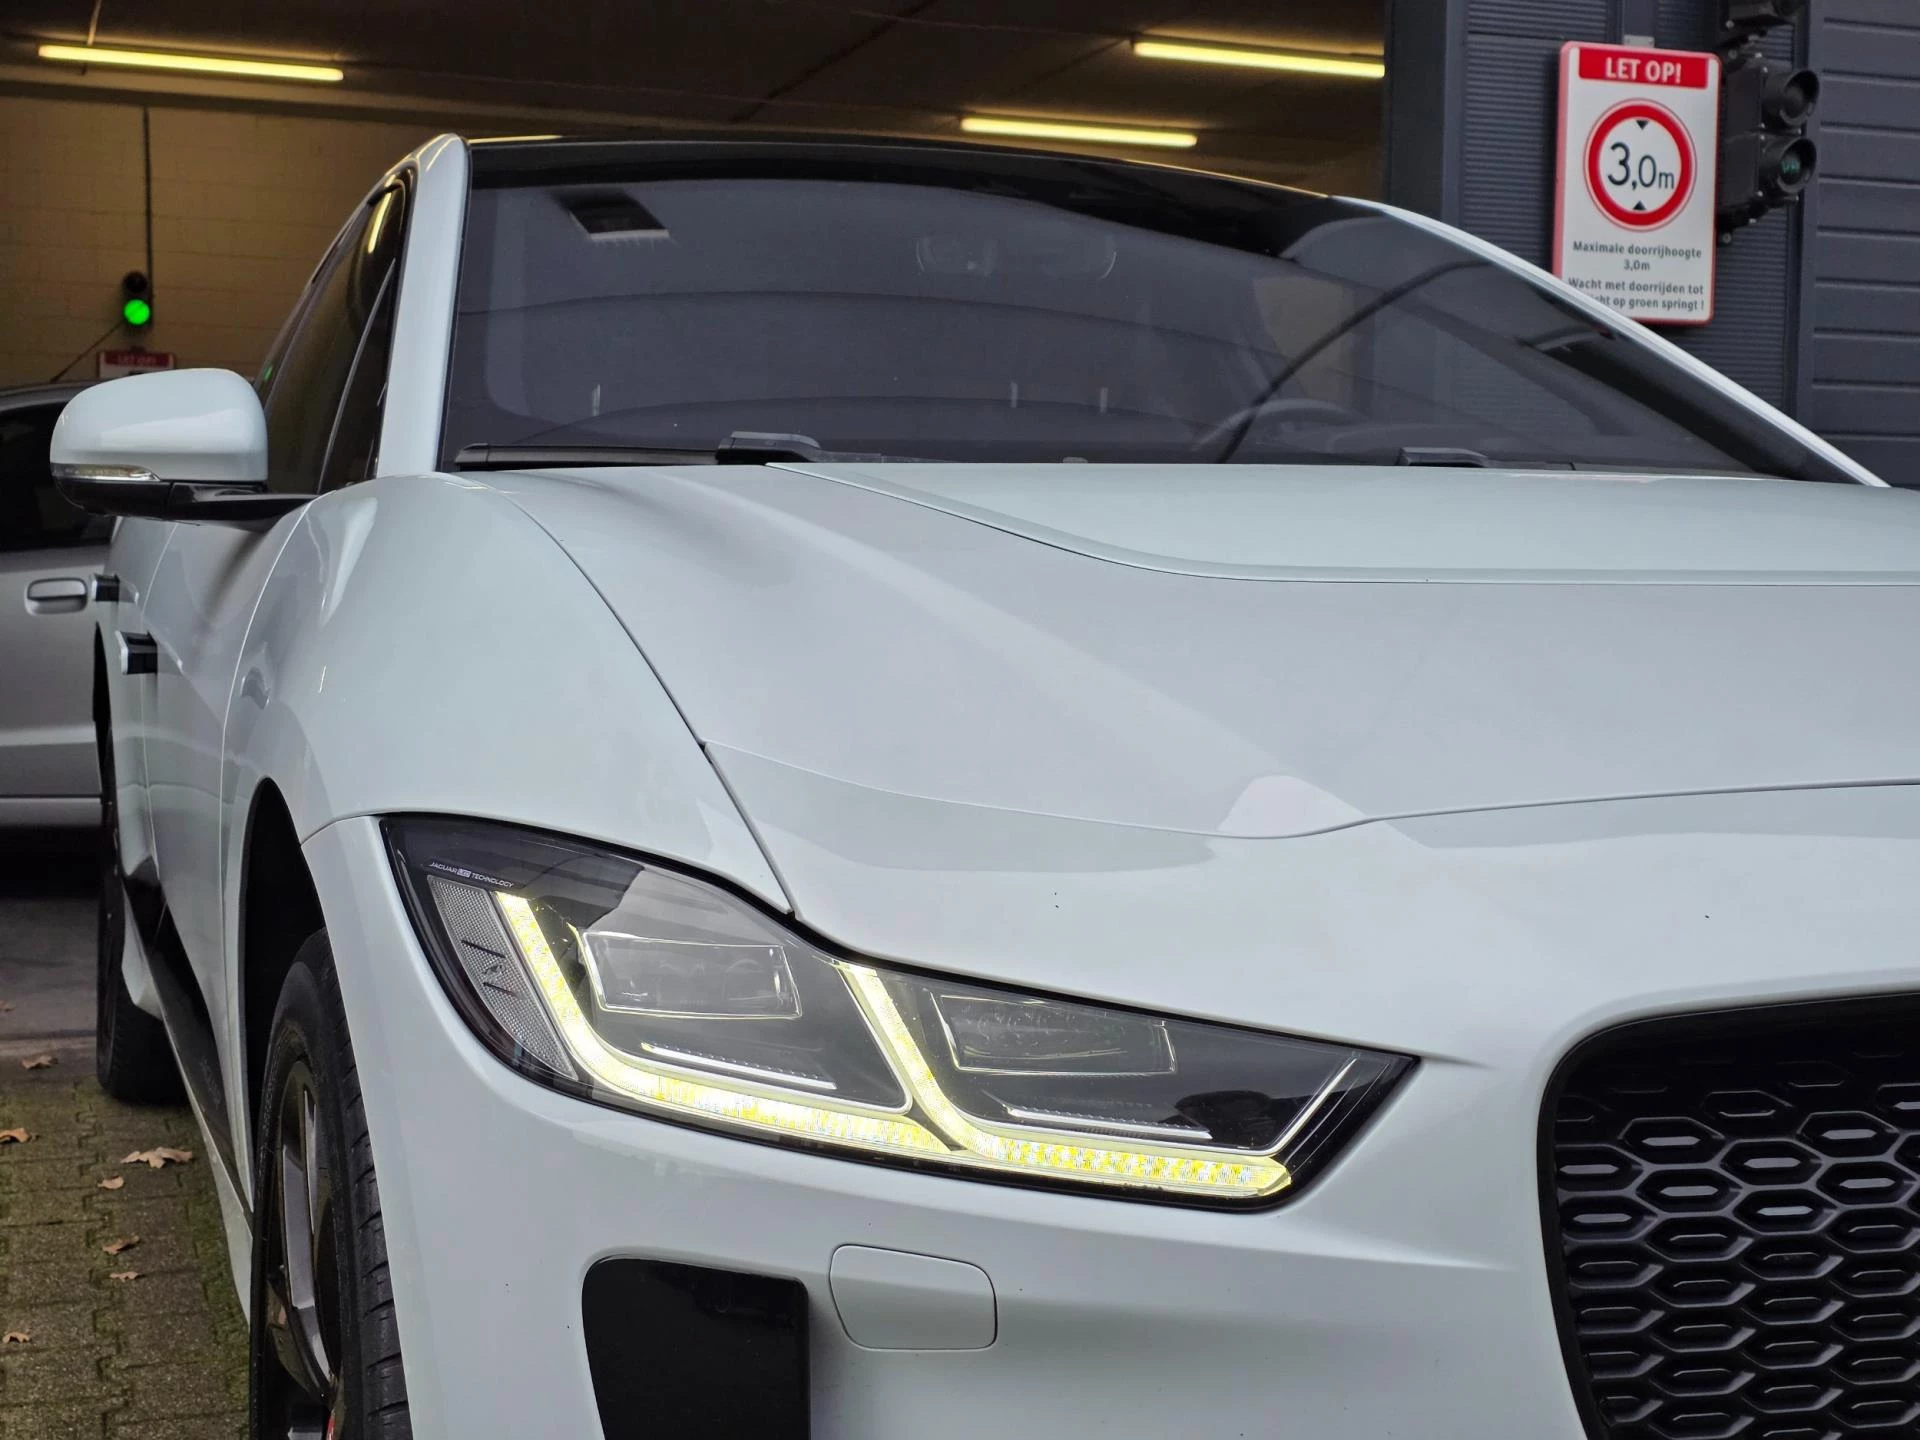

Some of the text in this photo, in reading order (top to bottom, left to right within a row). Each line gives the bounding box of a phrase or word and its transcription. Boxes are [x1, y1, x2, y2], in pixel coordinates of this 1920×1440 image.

[1605, 56, 1682, 84] LET OP!
[1607, 142, 1675, 190] 3,0m
[1572, 241, 1702, 260] Maximale doorrijhoogte
[1623, 260, 1651, 271] 3,0m
[1568, 277, 1704, 295] Wacht met doorrijden tot
[1613, 298, 1626, 308] op
[1629, 299, 1659, 310] groen
[1661, 299, 1698, 312] springt
[429, 861, 458, 874] JAGUAR
[471, 872, 514, 888] TECHNOLOGY
